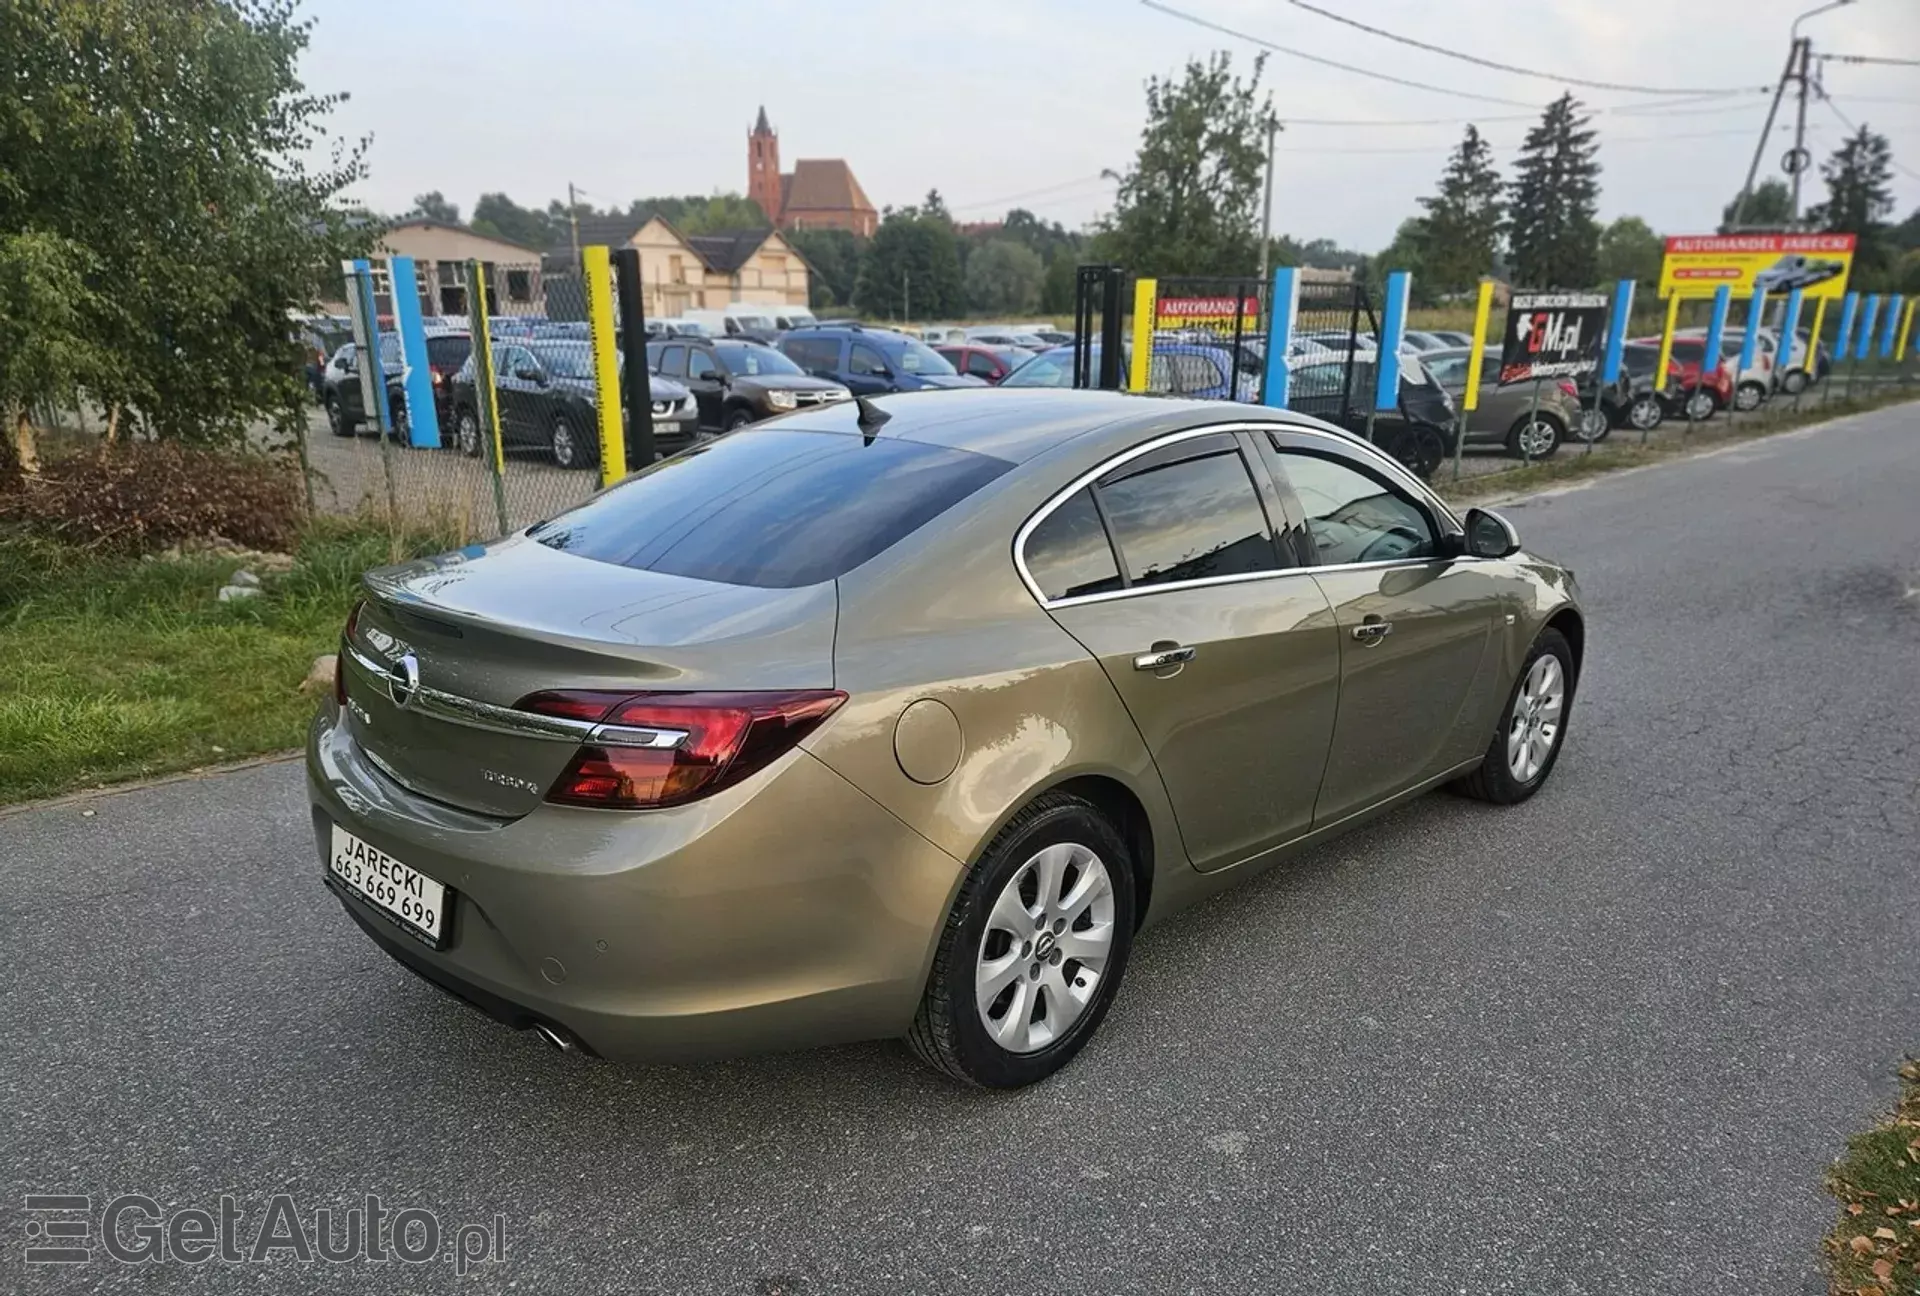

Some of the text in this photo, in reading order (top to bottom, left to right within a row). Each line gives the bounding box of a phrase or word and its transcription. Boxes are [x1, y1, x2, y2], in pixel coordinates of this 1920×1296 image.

[1164, 301, 1249, 314] AUTOHANDL
[335, 855, 362, 885] 663
[366, 875, 396, 906] 669
[401, 897, 435, 930] 699
[345, 838, 424, 898] JARECKI
